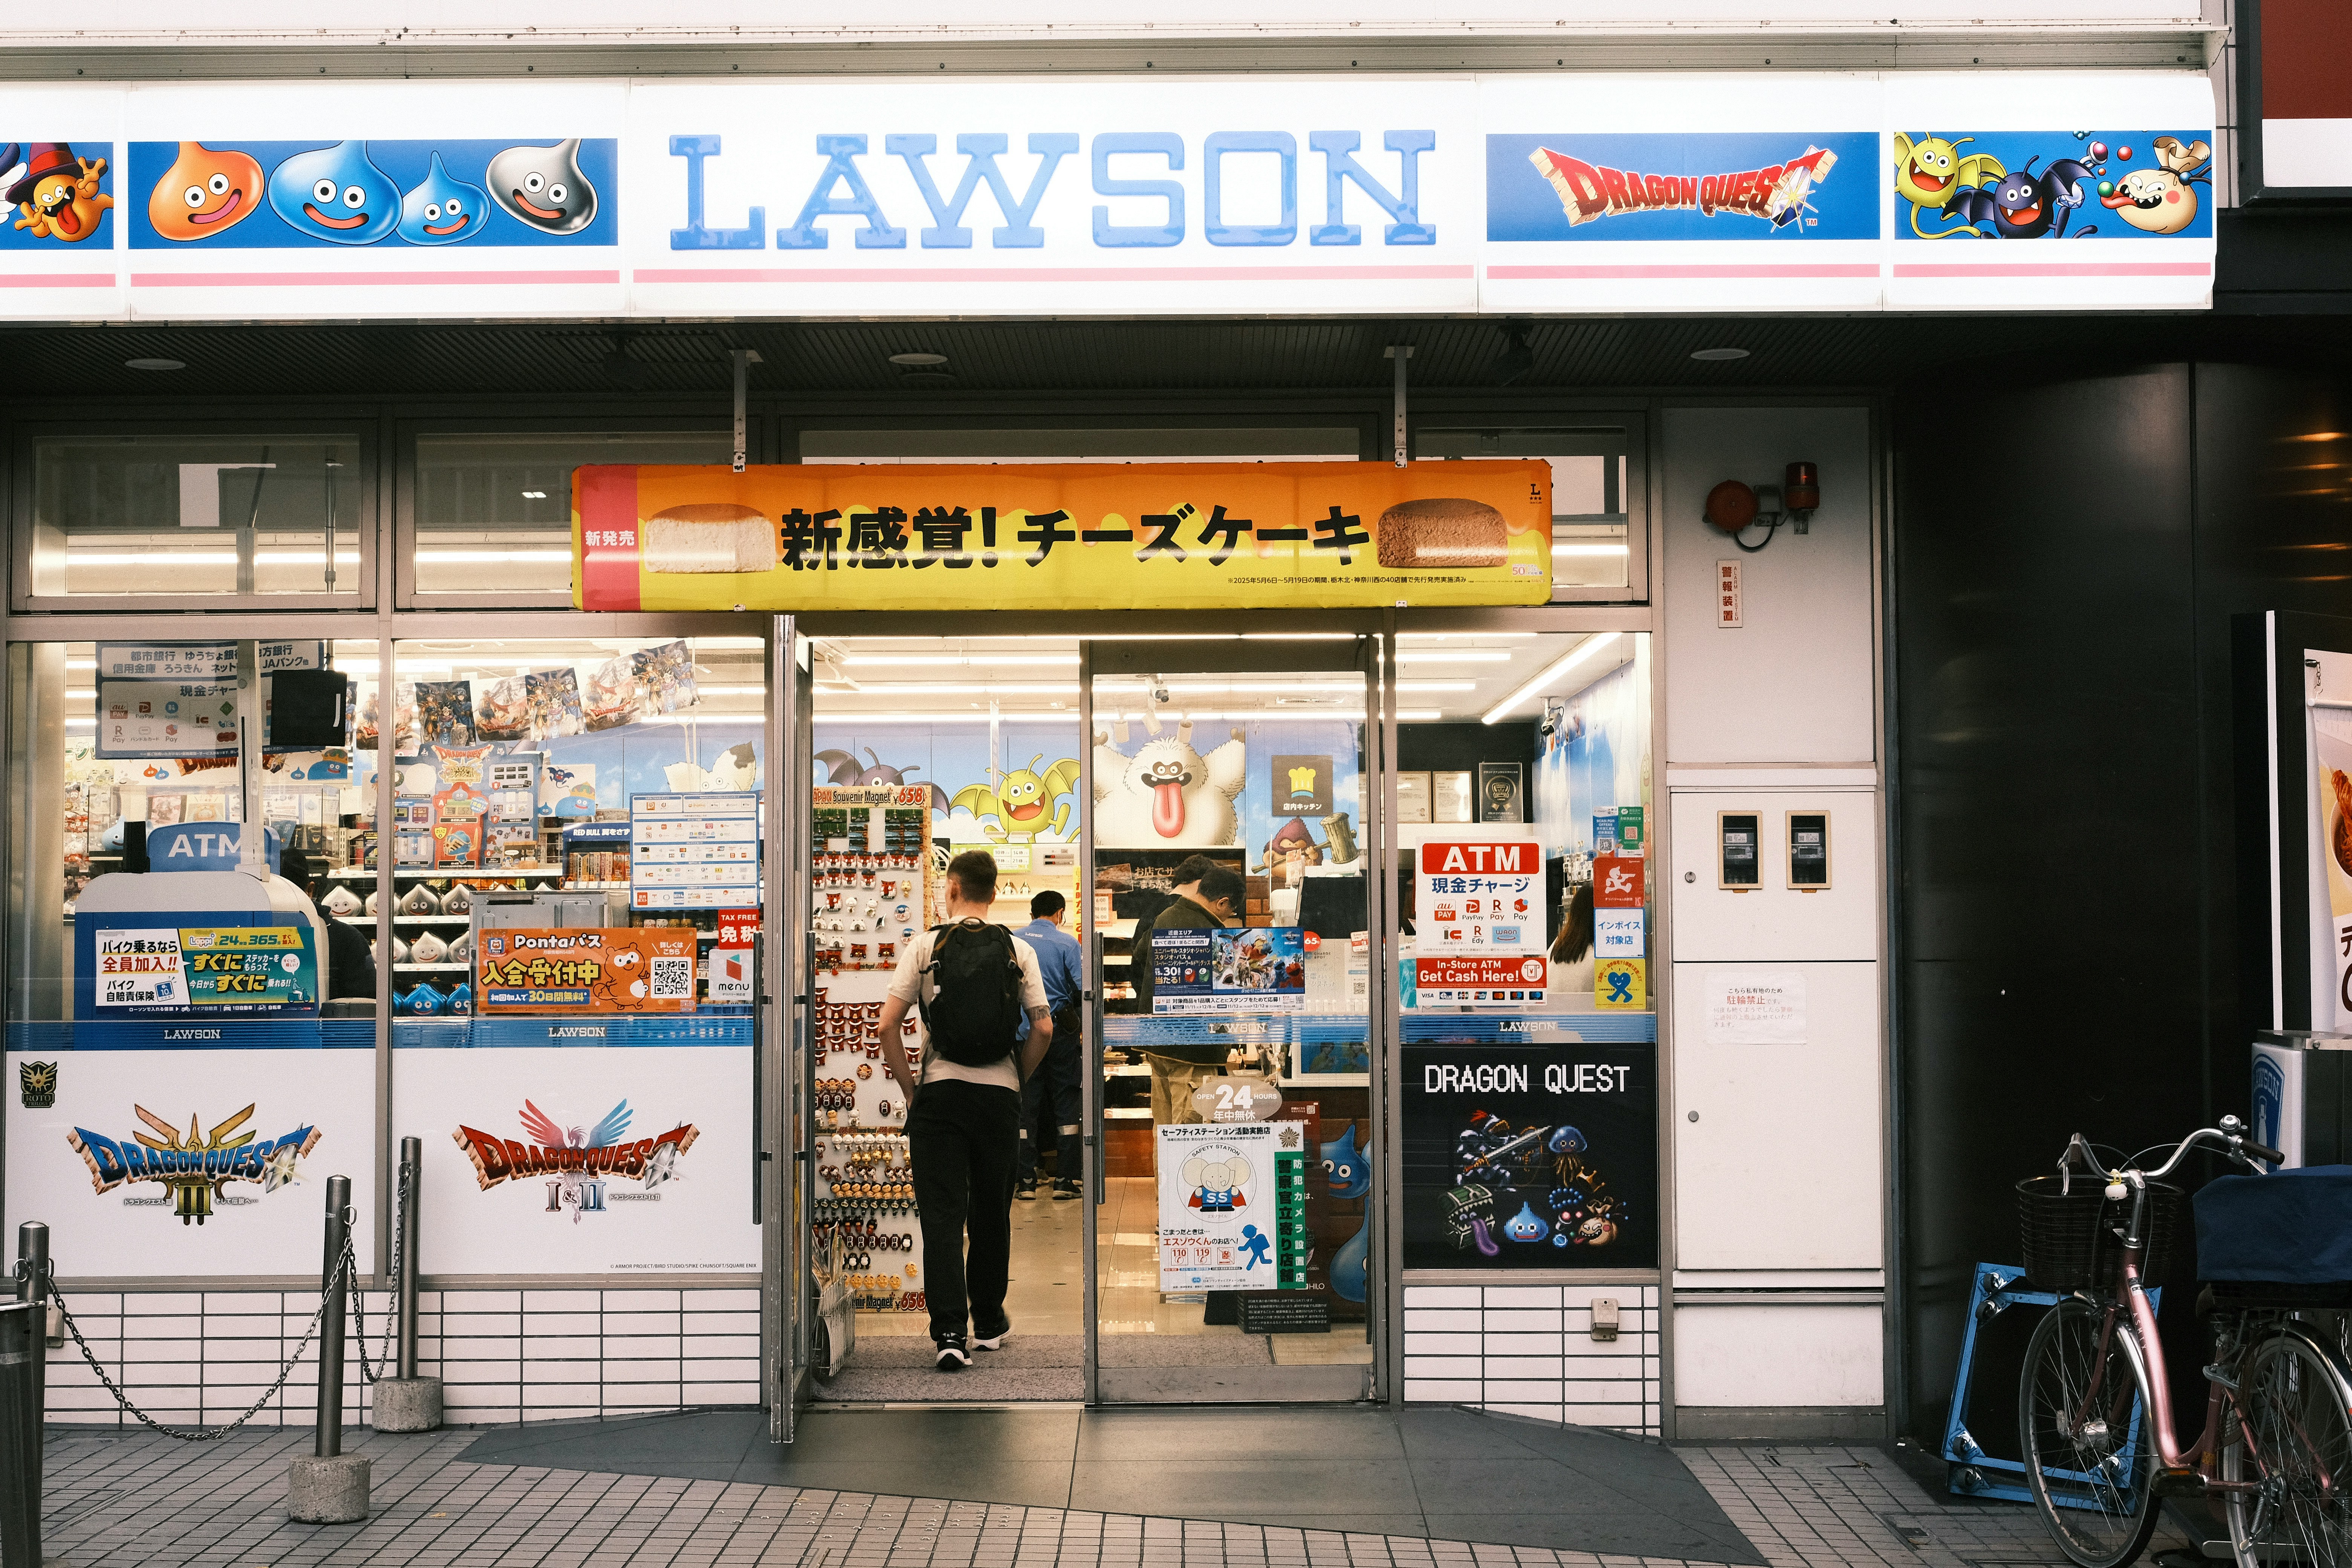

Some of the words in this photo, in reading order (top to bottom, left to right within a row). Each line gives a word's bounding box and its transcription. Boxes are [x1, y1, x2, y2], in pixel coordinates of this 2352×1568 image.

[669, 130, 1436, 250] LAWSON
[1530, 147, 1698, 226] DRAGON
[585, 530, 634, 546] 新発売
[1721, 566, 1733, 621] 警報装置
[131, 651, 176, 661] 都市銀行
[113, 663, 156, 674] 信用金庫
[164, 663, 202, 672] ろうきん
[180, 686, 237, 697] 現金チャー
[813, 790, 831, 804] APAN
[833, 790, 863, 803] Souvenir
[865, 791, 890, 806] Magnet
[168, 834, 240, 857] ATM
[1442, 846, 1520, 871] ATM
[1432, 877, 1530, 894] 現金チャージ
[1493, 900, 1502, 911] R
[721, 926, 756, 943] 免税
[1475, 926, 1481, 935] R
[103, 940, 177, 953] バイク乗るなら
[514, 934, 601, 948] Pontaパス
[1606, 936, 1633, 945] 対象店
[103, 957, 177, 972] 全員加入!!
[194, 954, 242, 971] すぐに
[482, 959, 599, 985] 入会受付中
[1420, 971, 1442, 982] Get
[1446, 970, 1478, 982] Cash
[1483, 970, 1519, 982] Here!
[107, 980, 134, 990] バイク
[217, 975, 266, 991] すぐに
[107, 991, 155, 1001] 自賠責保険
[164, 1030, 220, 1039] LAWSON
[549, 1027, 605, 1037] LAWSON
[1425, 1065, 1527, 1092] DRAGON
[1545, 1065, 1629, 1093] QUEST
[2254, 1067, 2279, 1101] AWSON
[1216, 1084, 1253, 1109] 24
[1214, 1110, 1255, 1121] 年中無休
[1162, 1127, 1270, 1136] セーフティステーション活動実施店
[452, 1125, 585, 1192] DRAGON
[584, 1123, 700, 1184] QUEST
[1192, 1145, 1213, 1157] SAFETY
[1216, 1144, 1240, 1156] STATION
[66, 1127, 204, 1195] DRAGON
[205, 1125, 322, 1185] QUEST
[1278, 1160, 1294, 1282] 警察官立寄り店舗
[1293, 1159, 1305, 1282] 防犯カメラ設置店
[867, 1295, 893, 1311] Magnet
